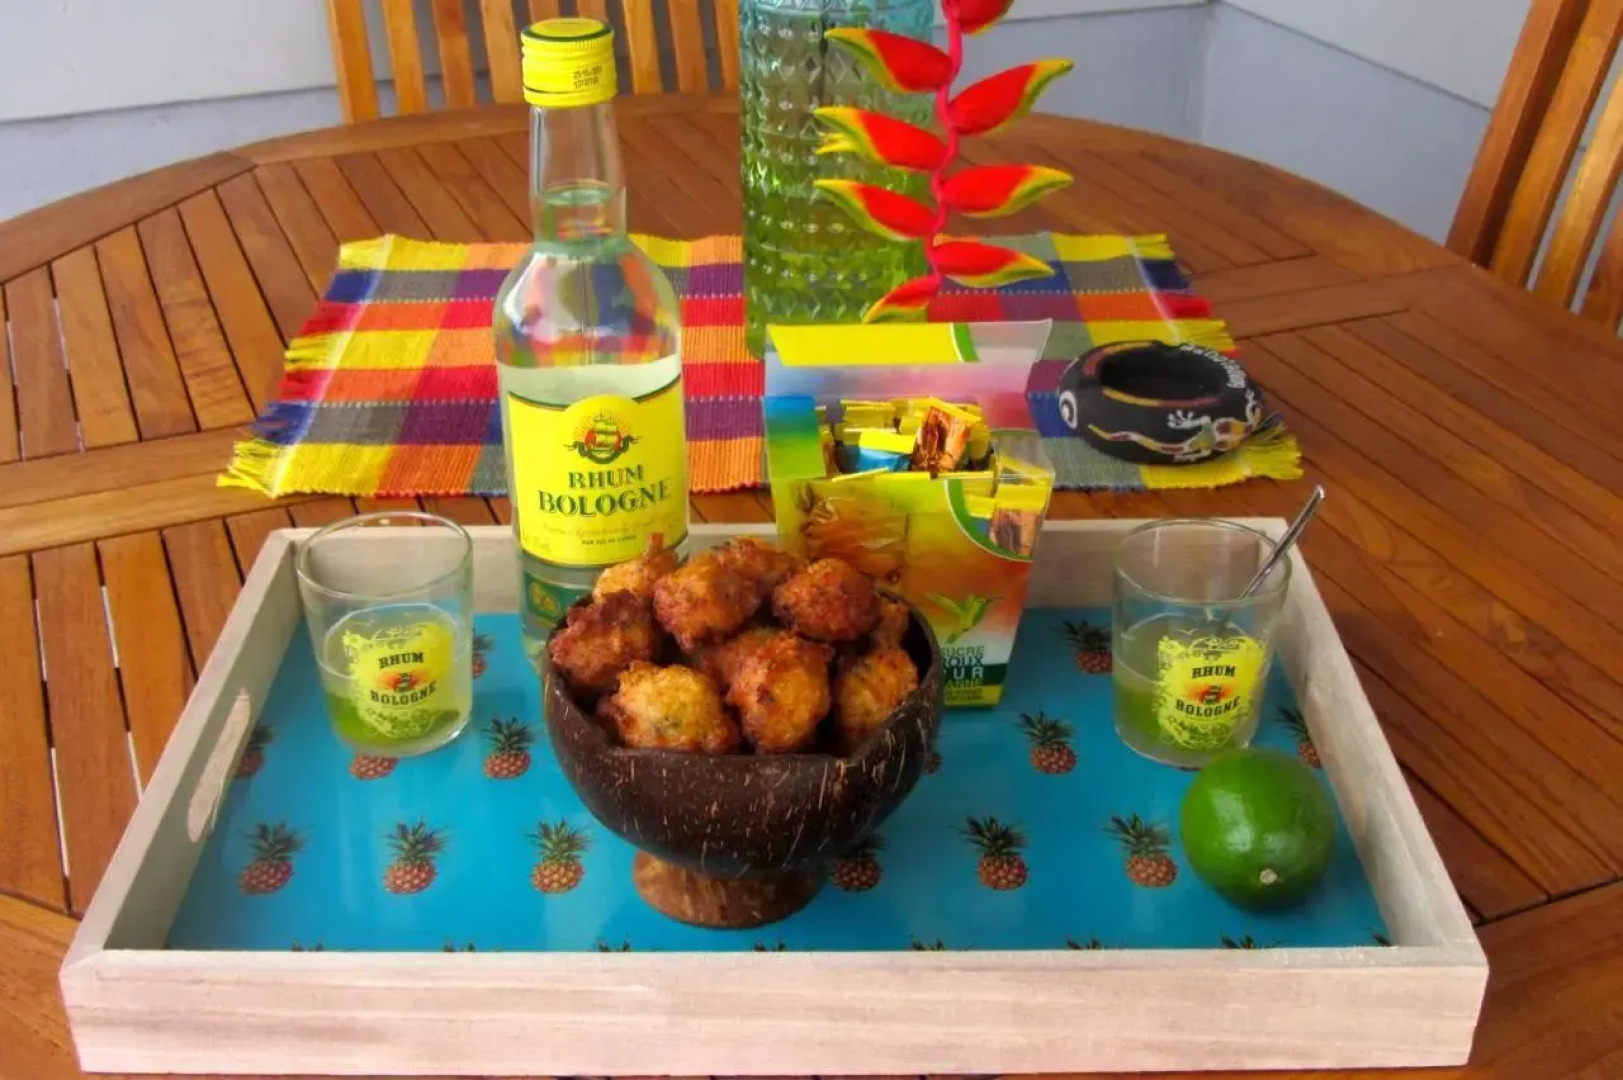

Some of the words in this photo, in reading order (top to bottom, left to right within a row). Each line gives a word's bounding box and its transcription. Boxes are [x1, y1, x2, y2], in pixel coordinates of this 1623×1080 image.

[568, 464, 643, 489] RHUM
[538, 477, 672, 517] BOLOGNE
[379, 652, 424, 668] RHUM
[1192, 665, 1236, 678] RHUM
[370, 680, 437, 705] BOLOGNE
[1176, 696, 1240, 717] BOLOGNE
